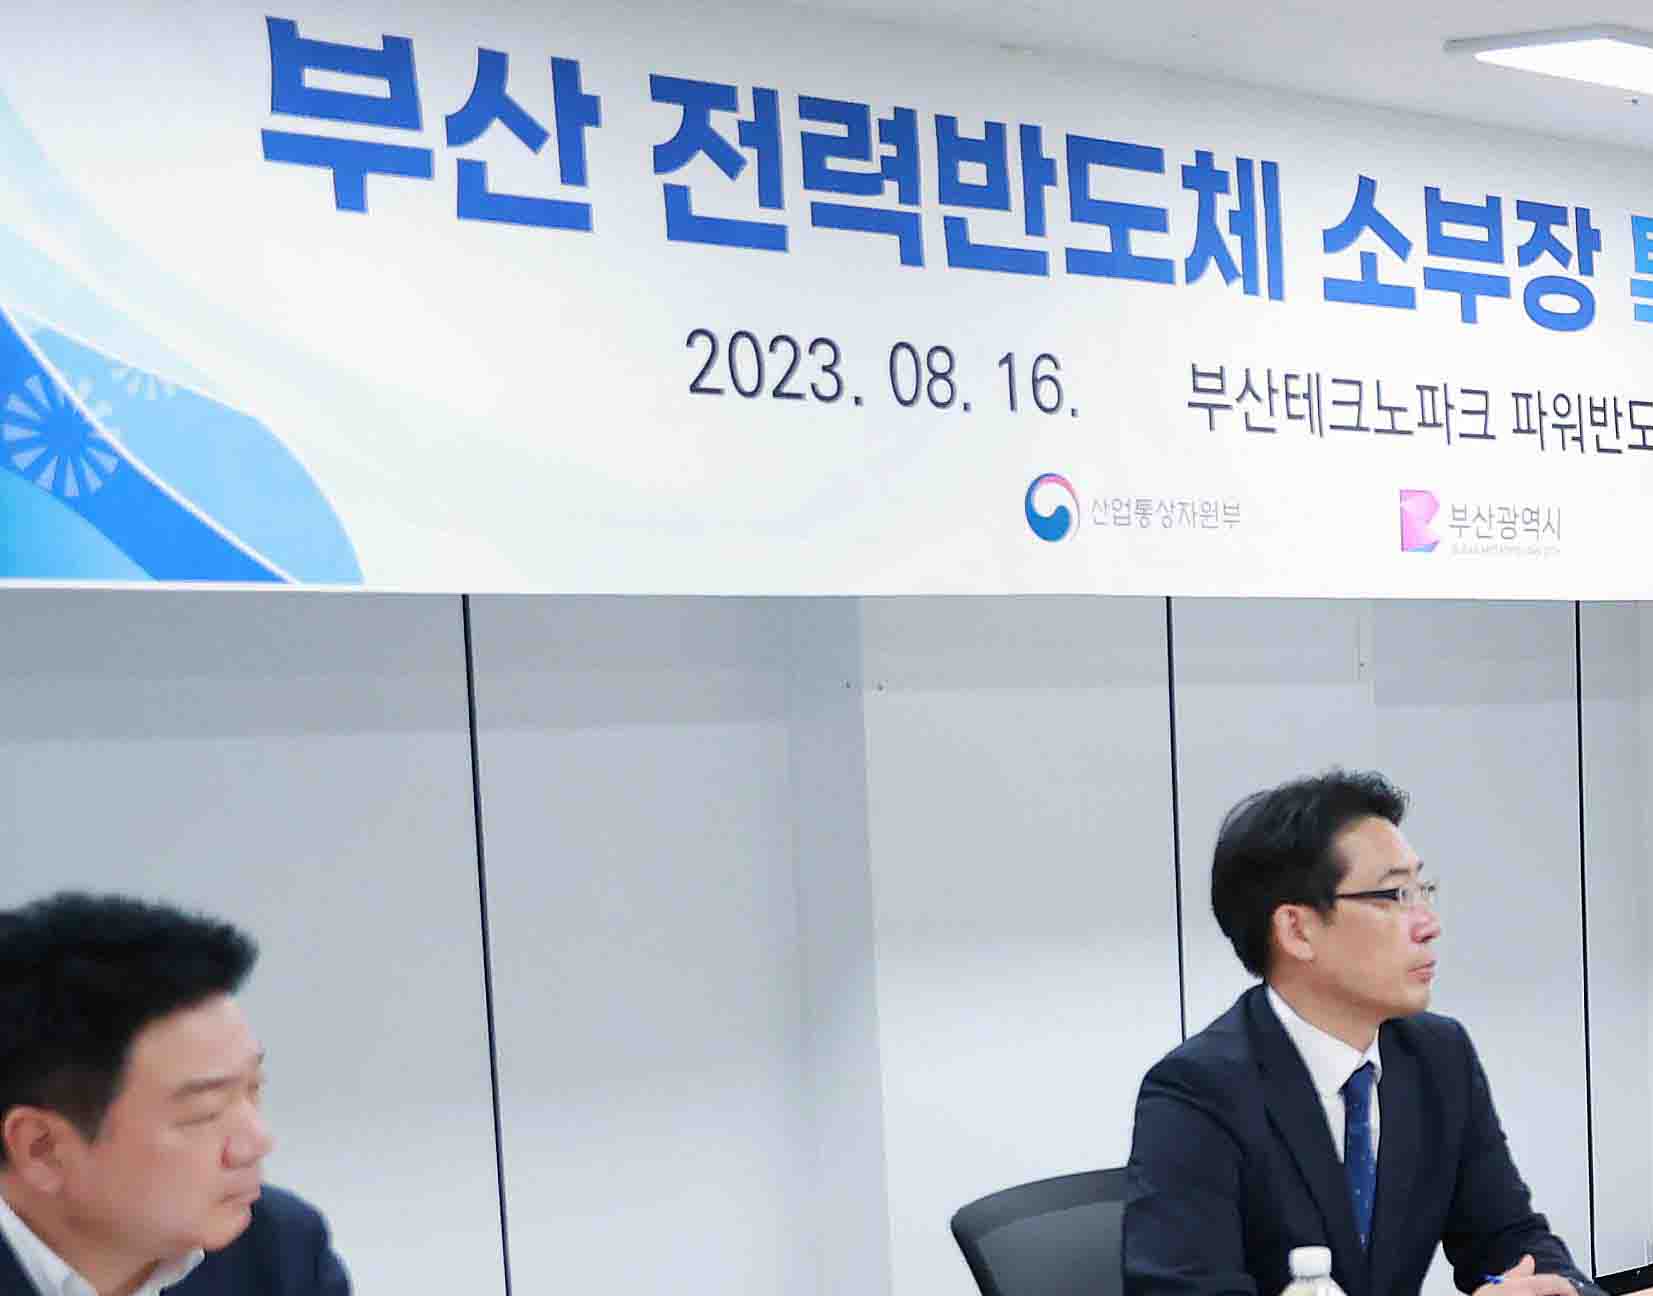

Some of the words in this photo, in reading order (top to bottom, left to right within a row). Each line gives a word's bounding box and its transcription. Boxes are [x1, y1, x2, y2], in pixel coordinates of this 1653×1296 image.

[261, 15, 601, 232] 부산
[648, 72, 1284, 302] 전력반도체
[1322, 174, 1602, 332] 소부장
[685, 327, 863, 407] 2023.
[888, 341, 972, 412] 08.
[997, 351, 1081, 418] 16.
[1187, 362, 1497, 446] 부산테크노파크
[1090, 496, 1242, 530] 산업통상자원부
[1447, 503, 1562, 542] 부산광역시
